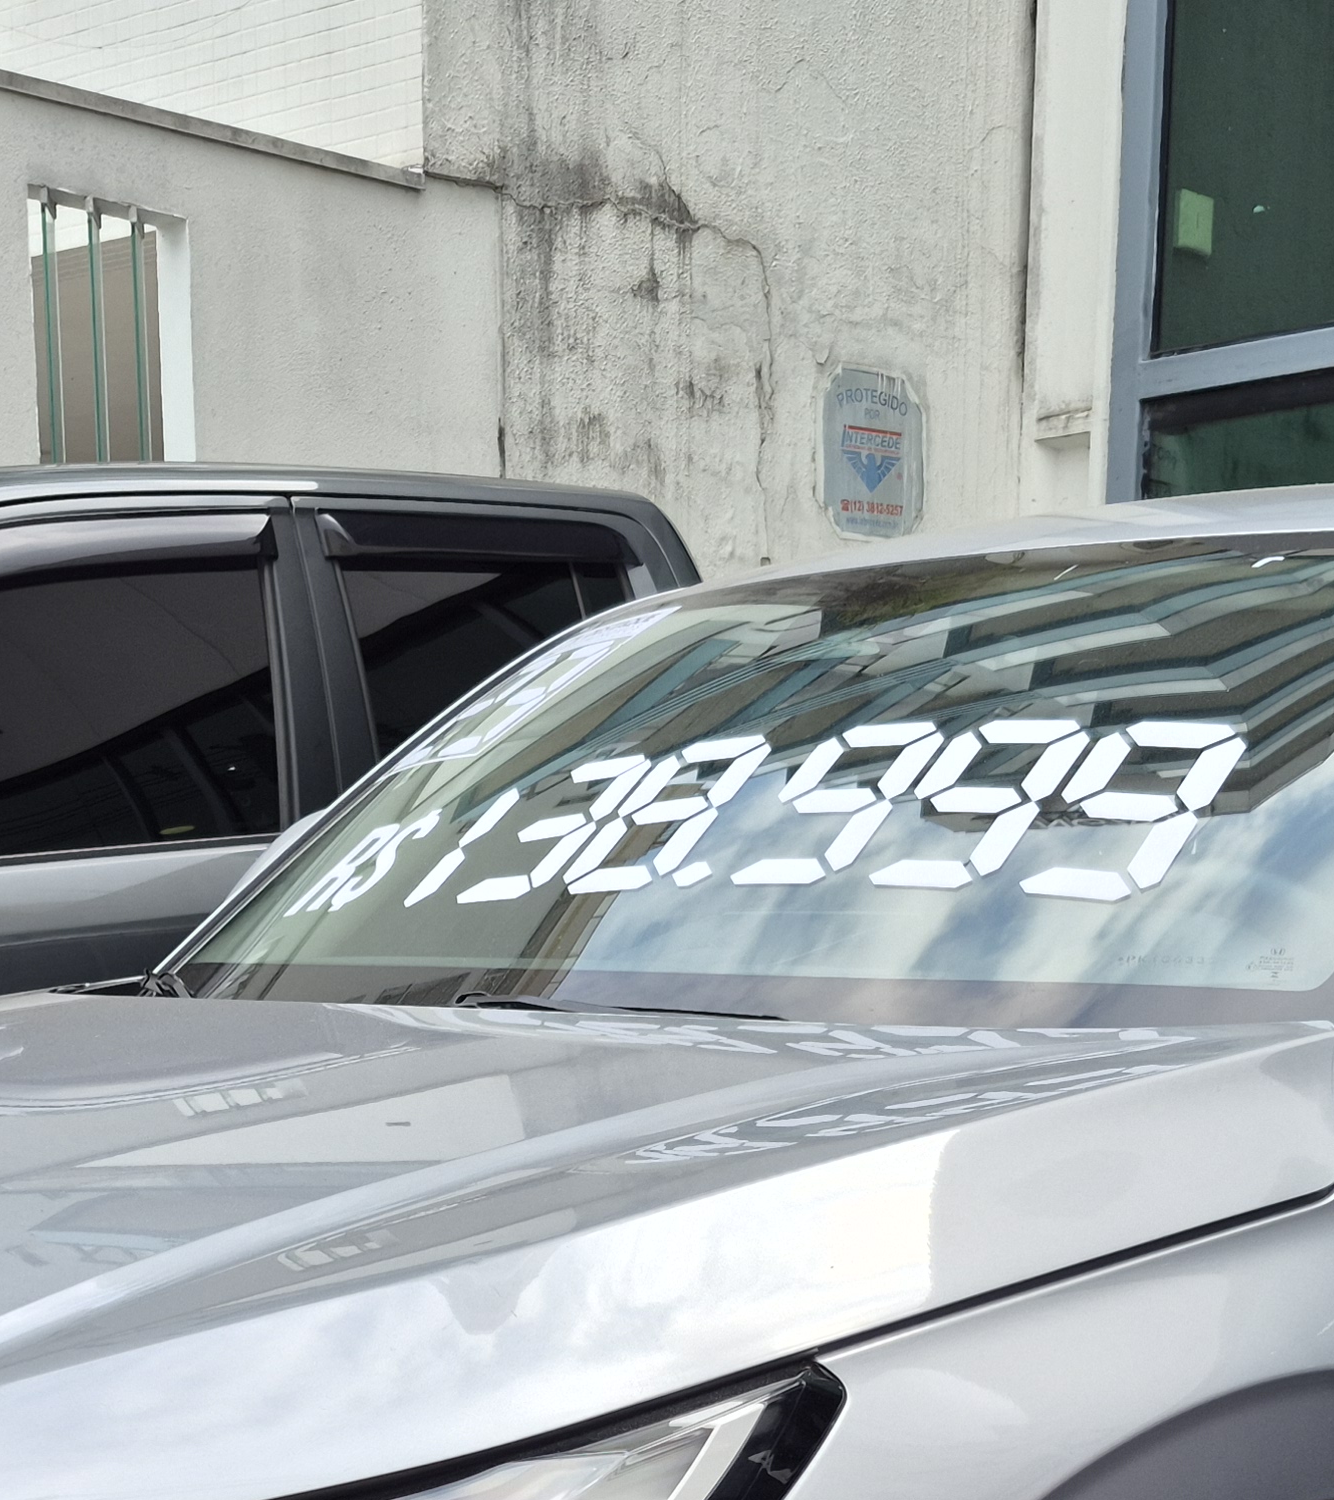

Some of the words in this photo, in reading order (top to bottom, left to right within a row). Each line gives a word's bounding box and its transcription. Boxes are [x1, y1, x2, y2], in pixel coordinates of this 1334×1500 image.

[836, 387, 908, 416] PROTEGIDO
[864, 407, 881, 421] POR
[841, 425, 902, 450] INTERCEDE
